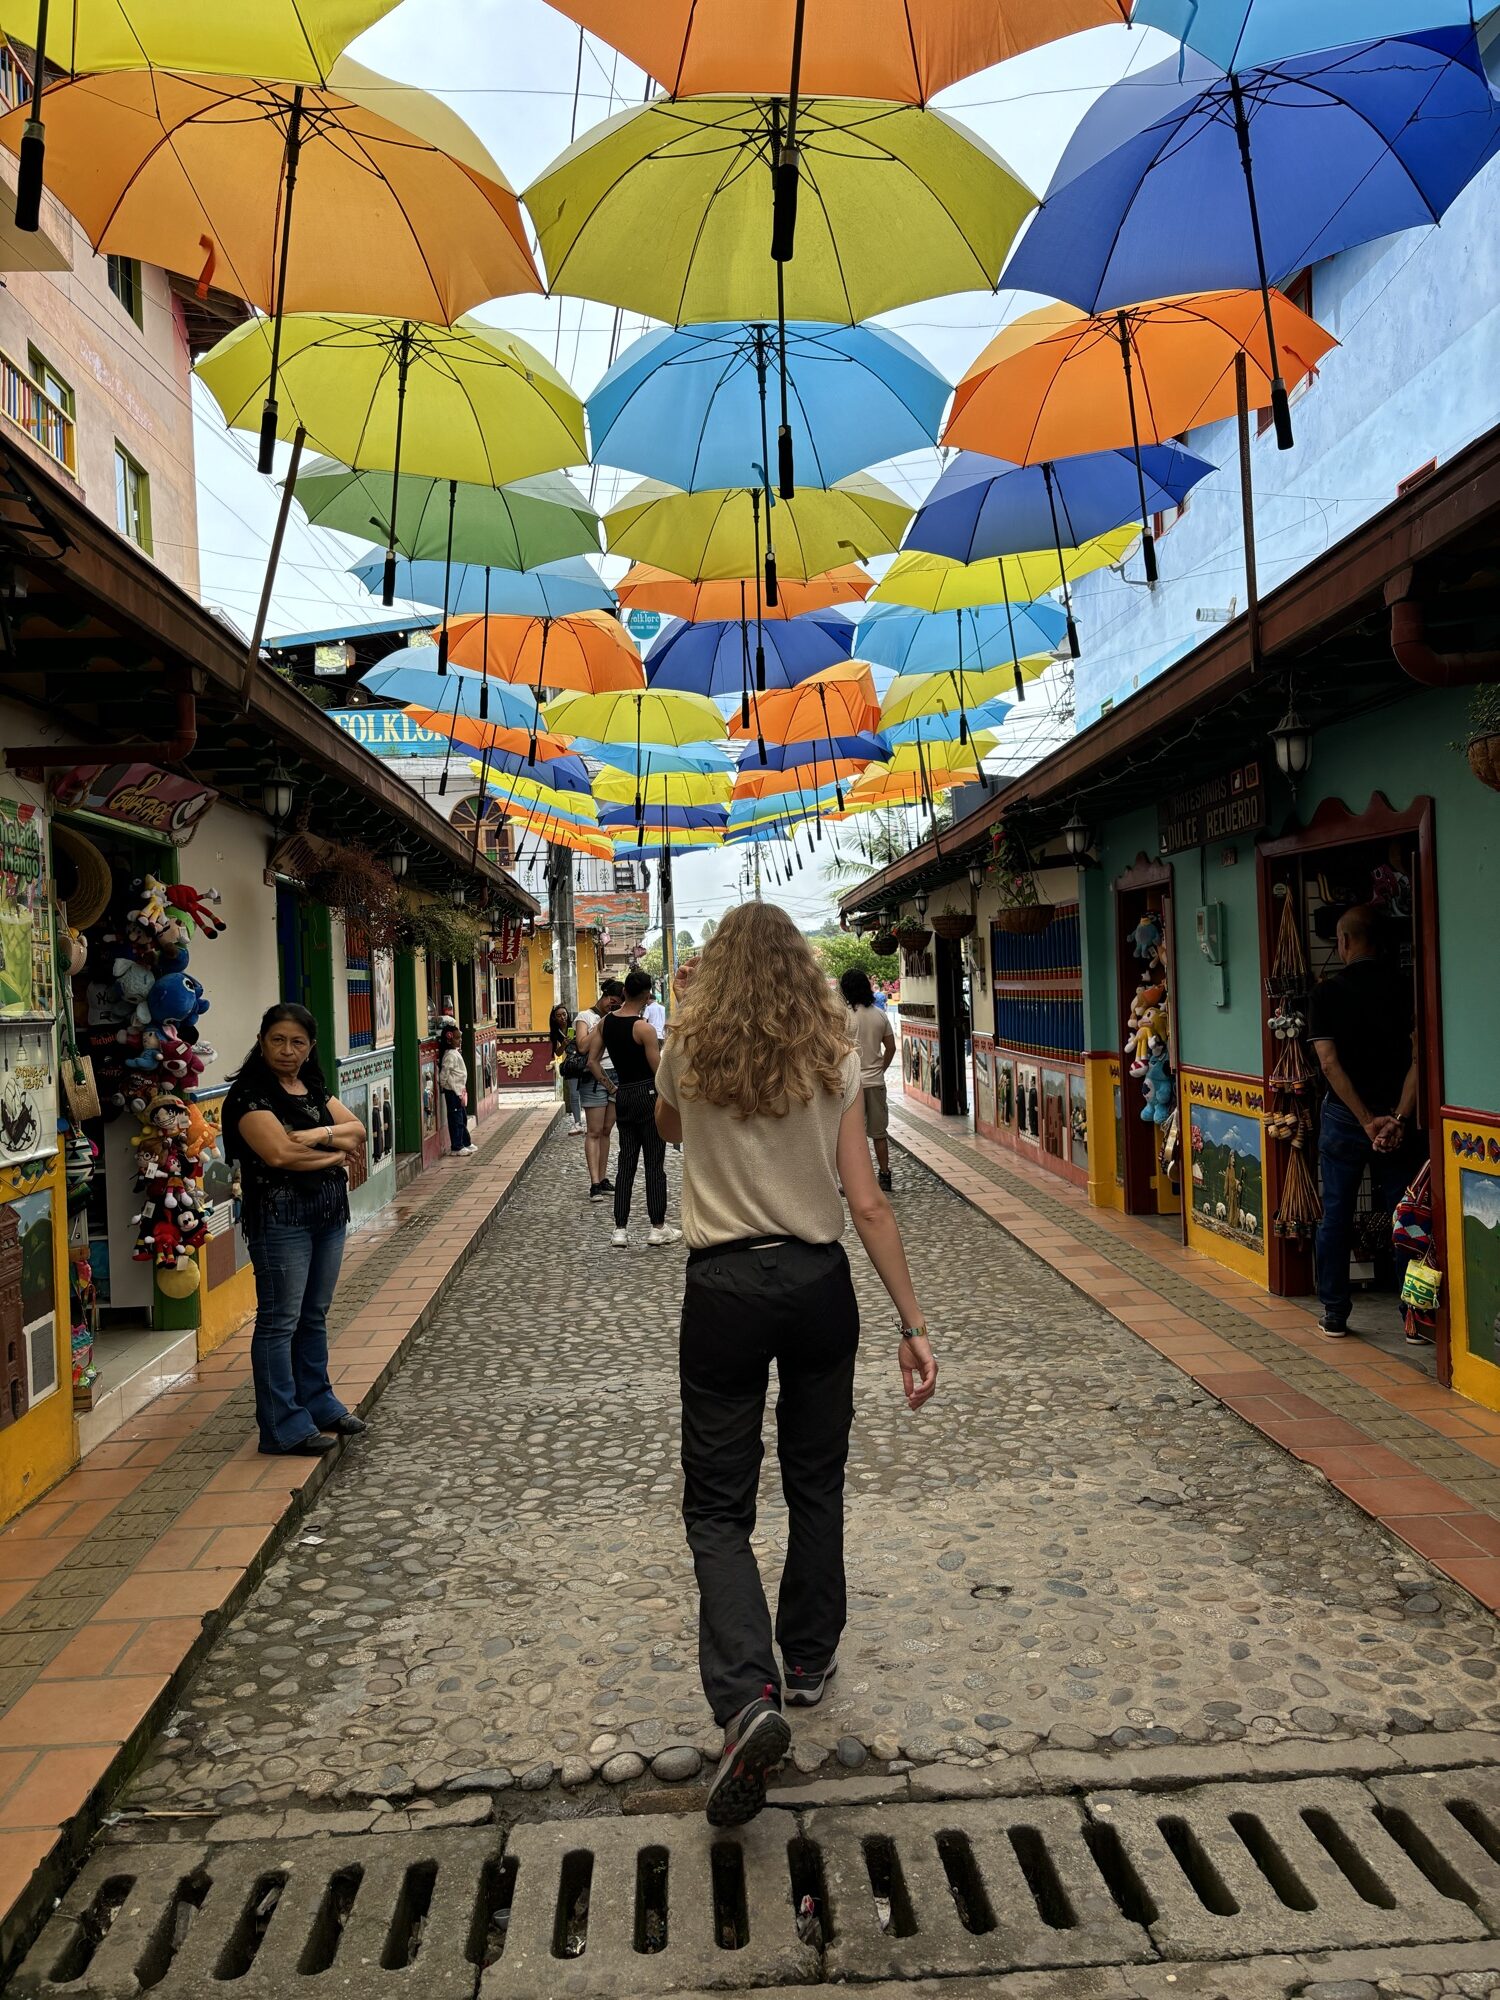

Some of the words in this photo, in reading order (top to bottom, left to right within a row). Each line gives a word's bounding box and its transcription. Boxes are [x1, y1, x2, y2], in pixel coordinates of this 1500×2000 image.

[334, 714, 449, 742] FOLKLO
[1168, 817, 1197, 849] DULCE
[1206, 796, 1258, 838] RECUERDO
[4, 846, 39, 883] Mango
